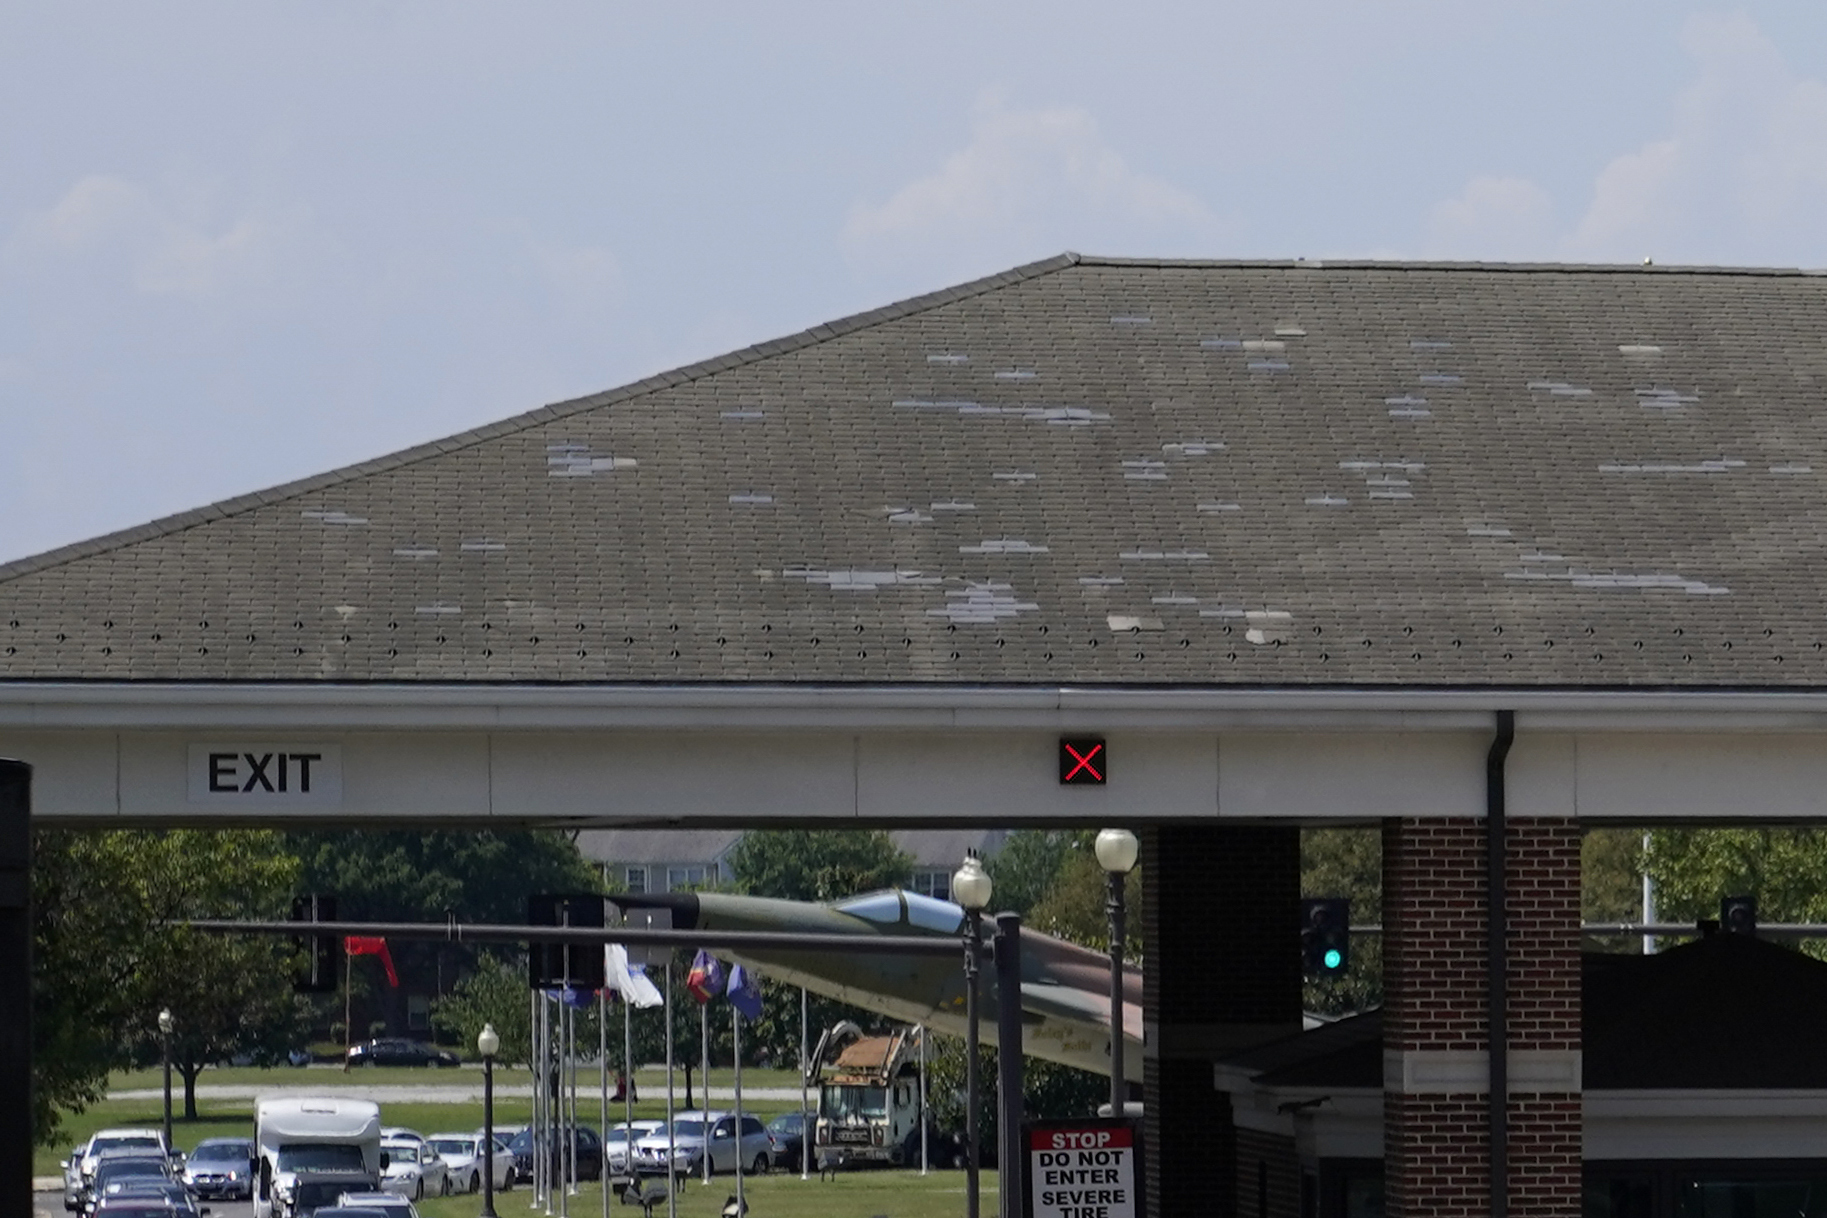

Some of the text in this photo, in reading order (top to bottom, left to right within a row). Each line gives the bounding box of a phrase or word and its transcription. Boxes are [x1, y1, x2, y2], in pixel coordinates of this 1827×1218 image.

[208, 753, 322, 793] EXIT
[1051, 1132, 1111, 1149] STOP
[1039, 1151, 1124, 1168] DO NOT
[1045, 1169, 1119, 1185] ENTER
[1042, 1190, 1125, 1206] SEVERE
